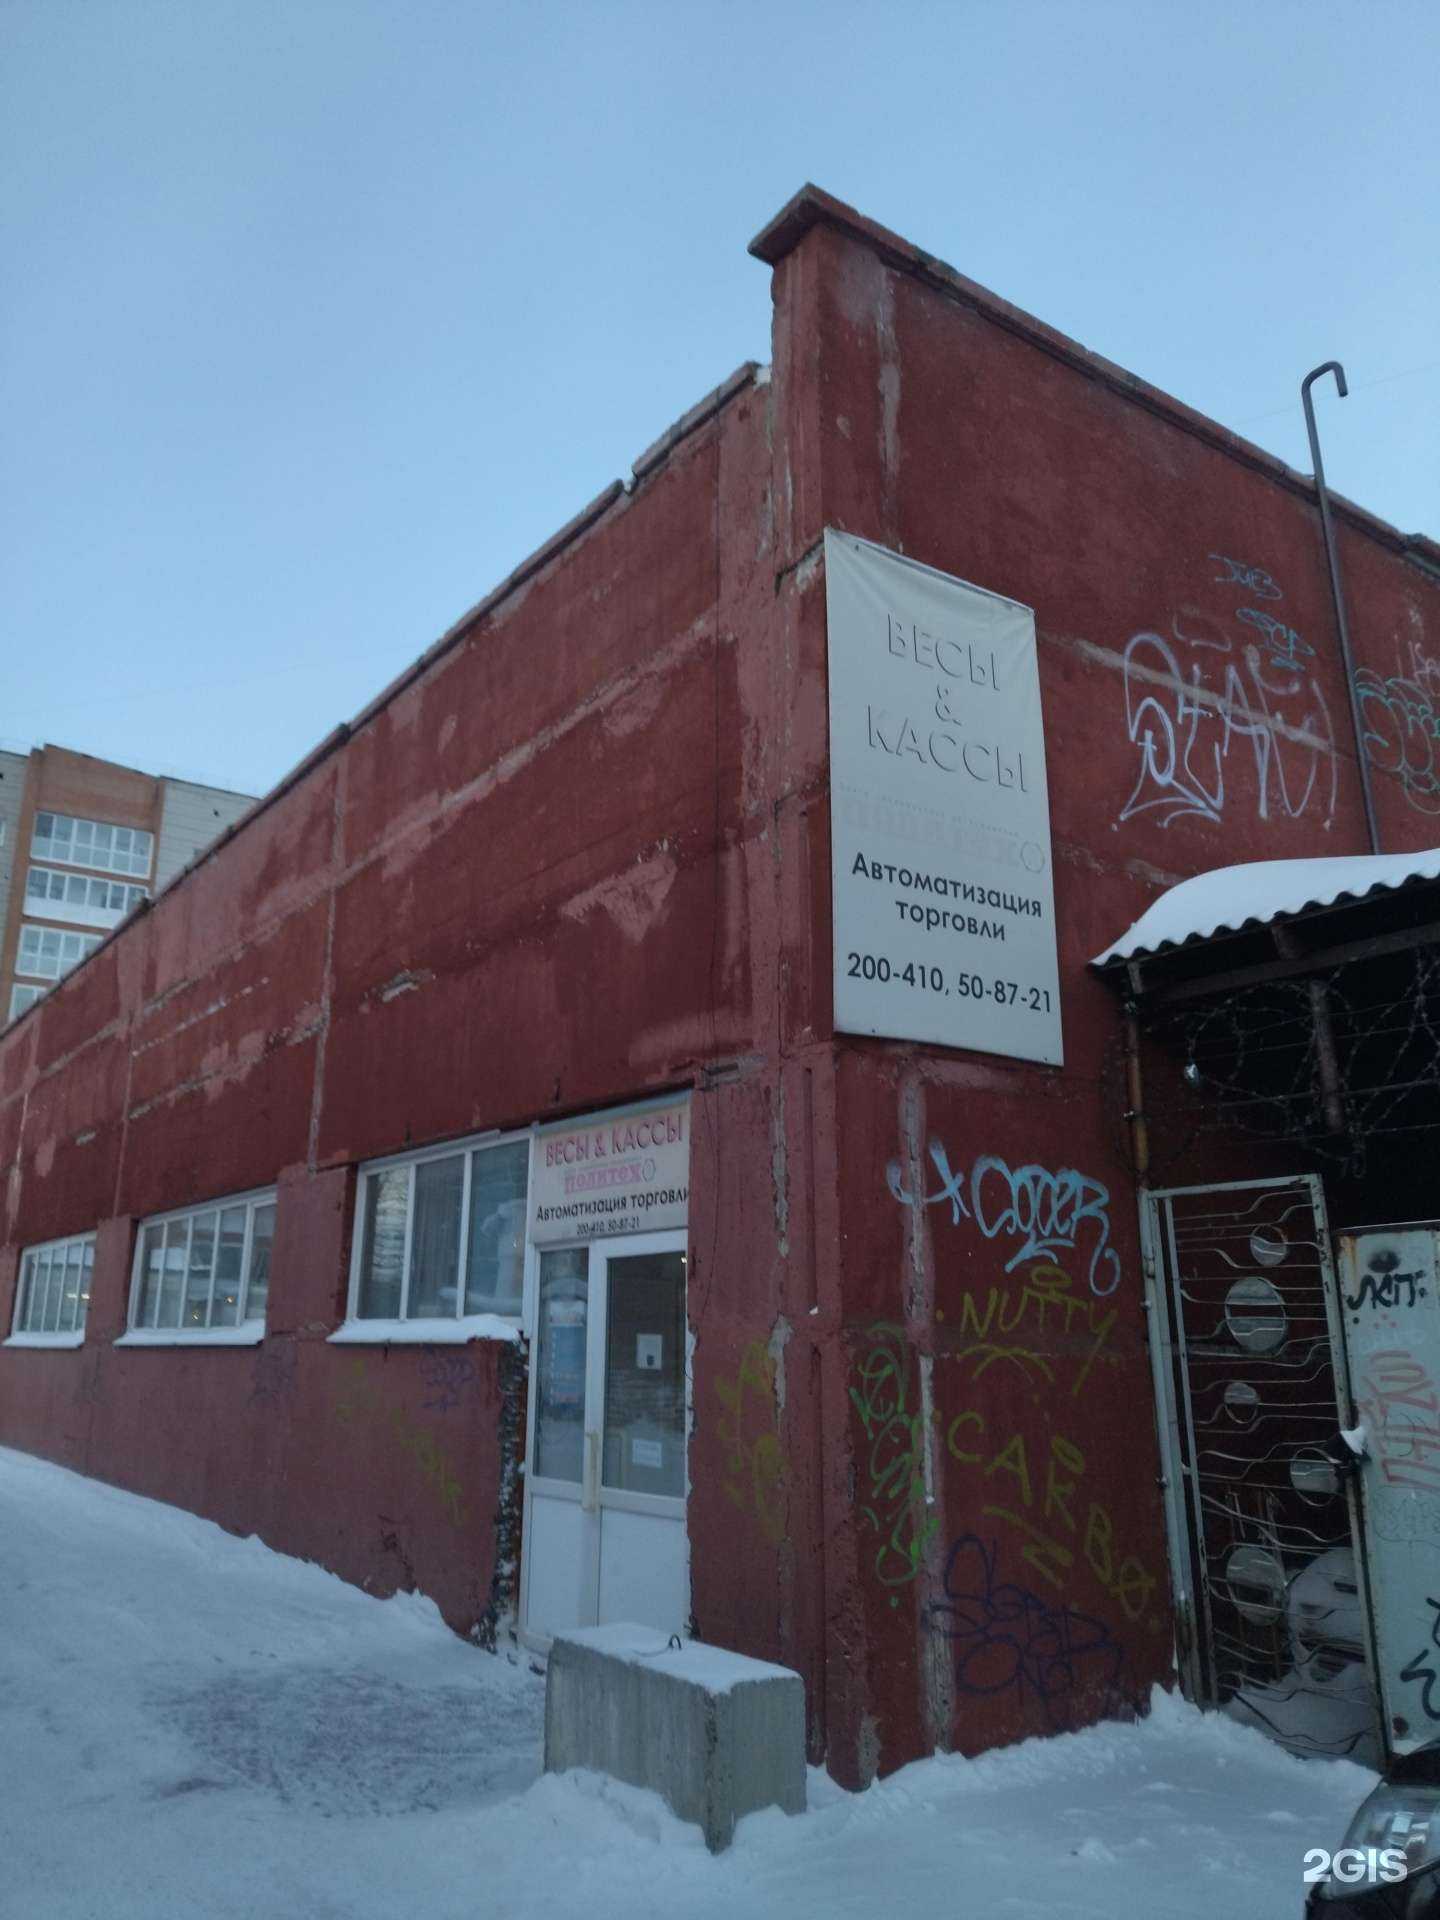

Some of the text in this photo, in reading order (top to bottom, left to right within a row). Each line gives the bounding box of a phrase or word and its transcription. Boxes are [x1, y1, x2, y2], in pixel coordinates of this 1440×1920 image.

[887, 612, 1001, 692] ВЕСЫ
[934, 683, 963, 727] &
[866, 703, 1029, 793] КАССЫ
[851, 851, 1043, 918] Автоматизация
[895, 900, 1006, 941] торговли
[846, 952, 1052, 1013] 200-410, 50-87-21
[545, 1113, 683, 1168] ВЕСЫ & КАССЫ
[536, 1195, 628, 1222] Автоматизация
